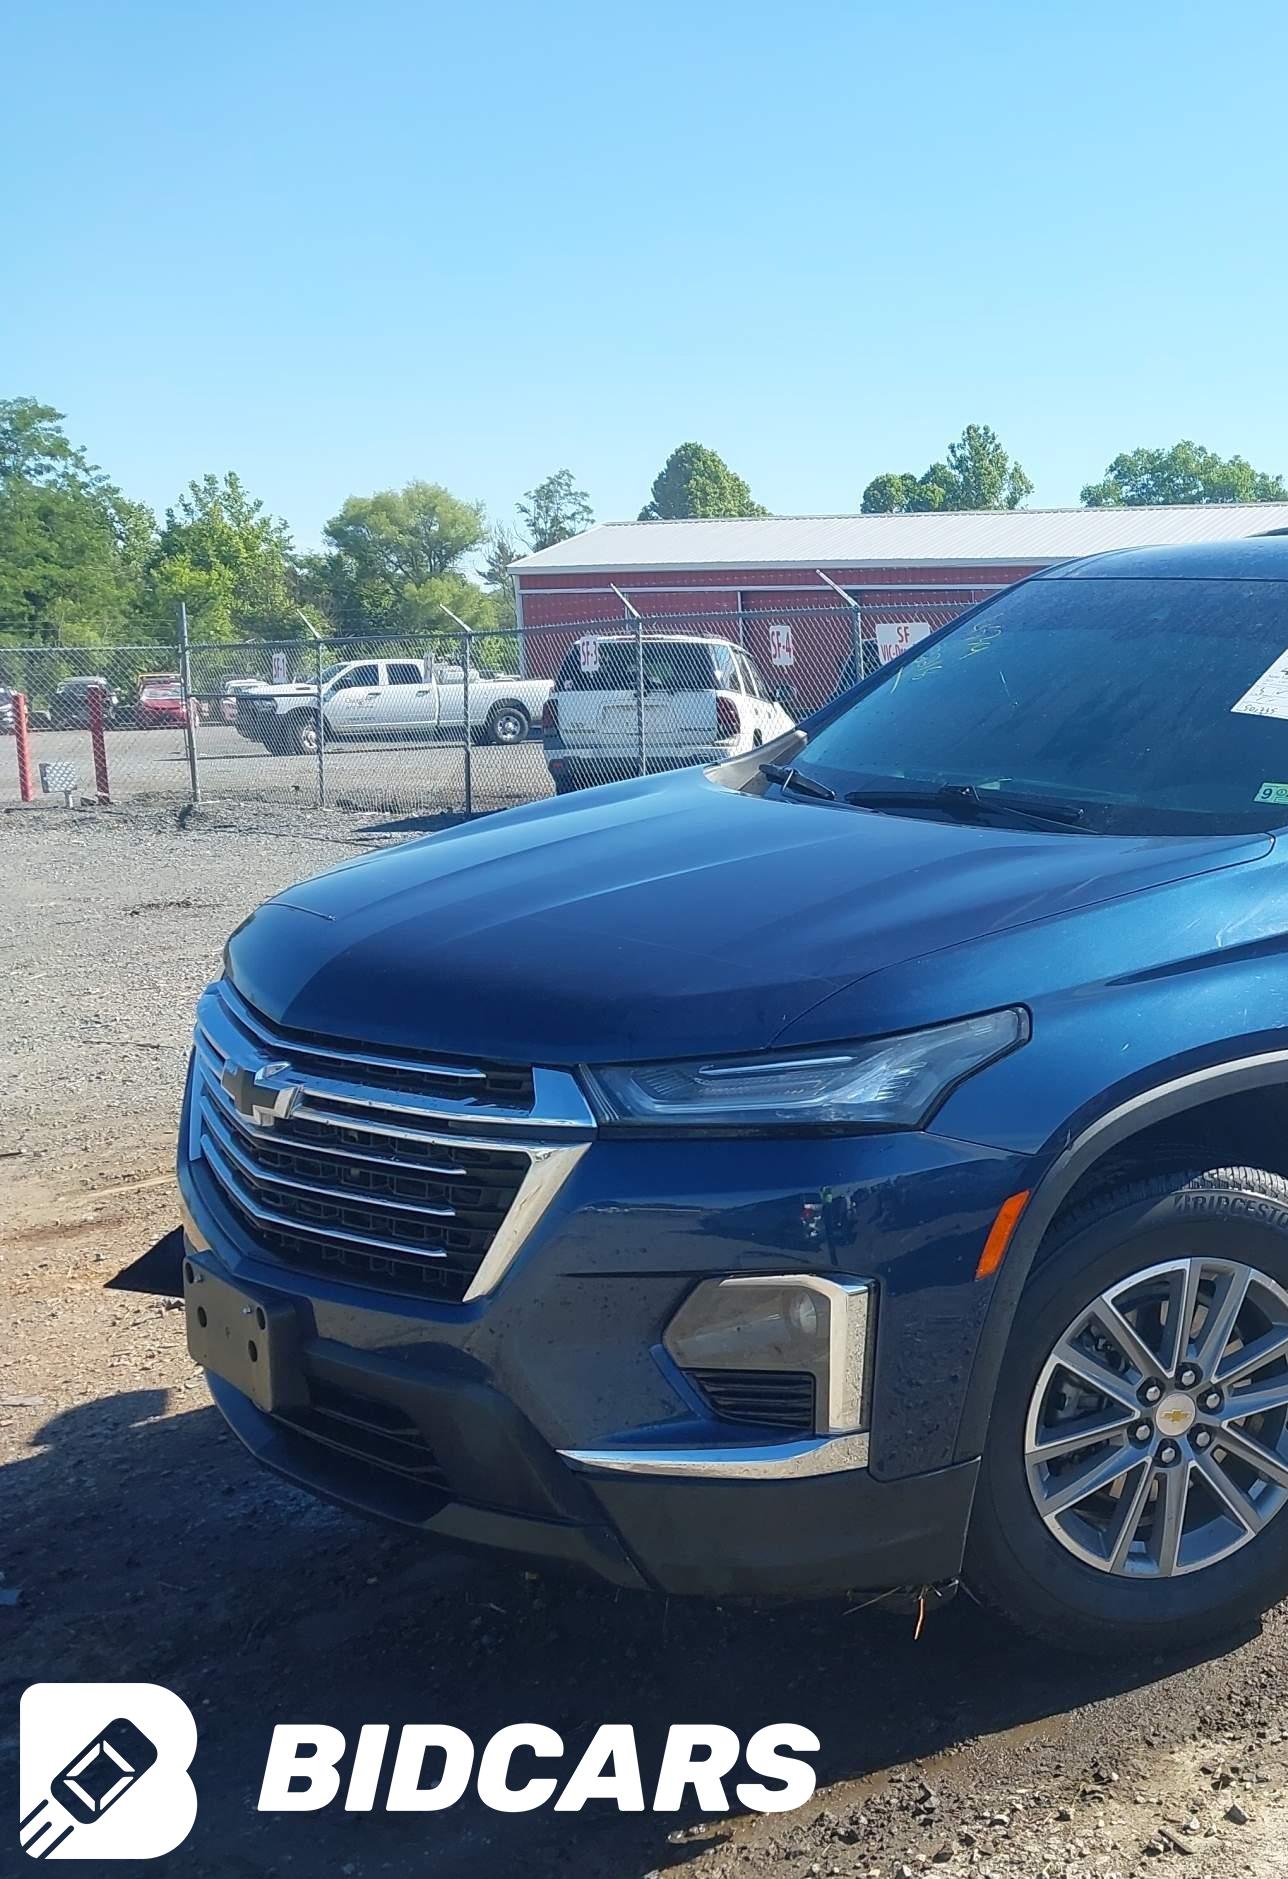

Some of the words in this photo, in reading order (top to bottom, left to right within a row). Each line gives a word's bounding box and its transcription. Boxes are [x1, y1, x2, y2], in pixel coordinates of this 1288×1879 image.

[770, 630, 792, 659] SF-4
[896, 626, 910, 643] SF
[581, 640, 598, 666] SF-3
[1261, 788, 1273, 799] 9
